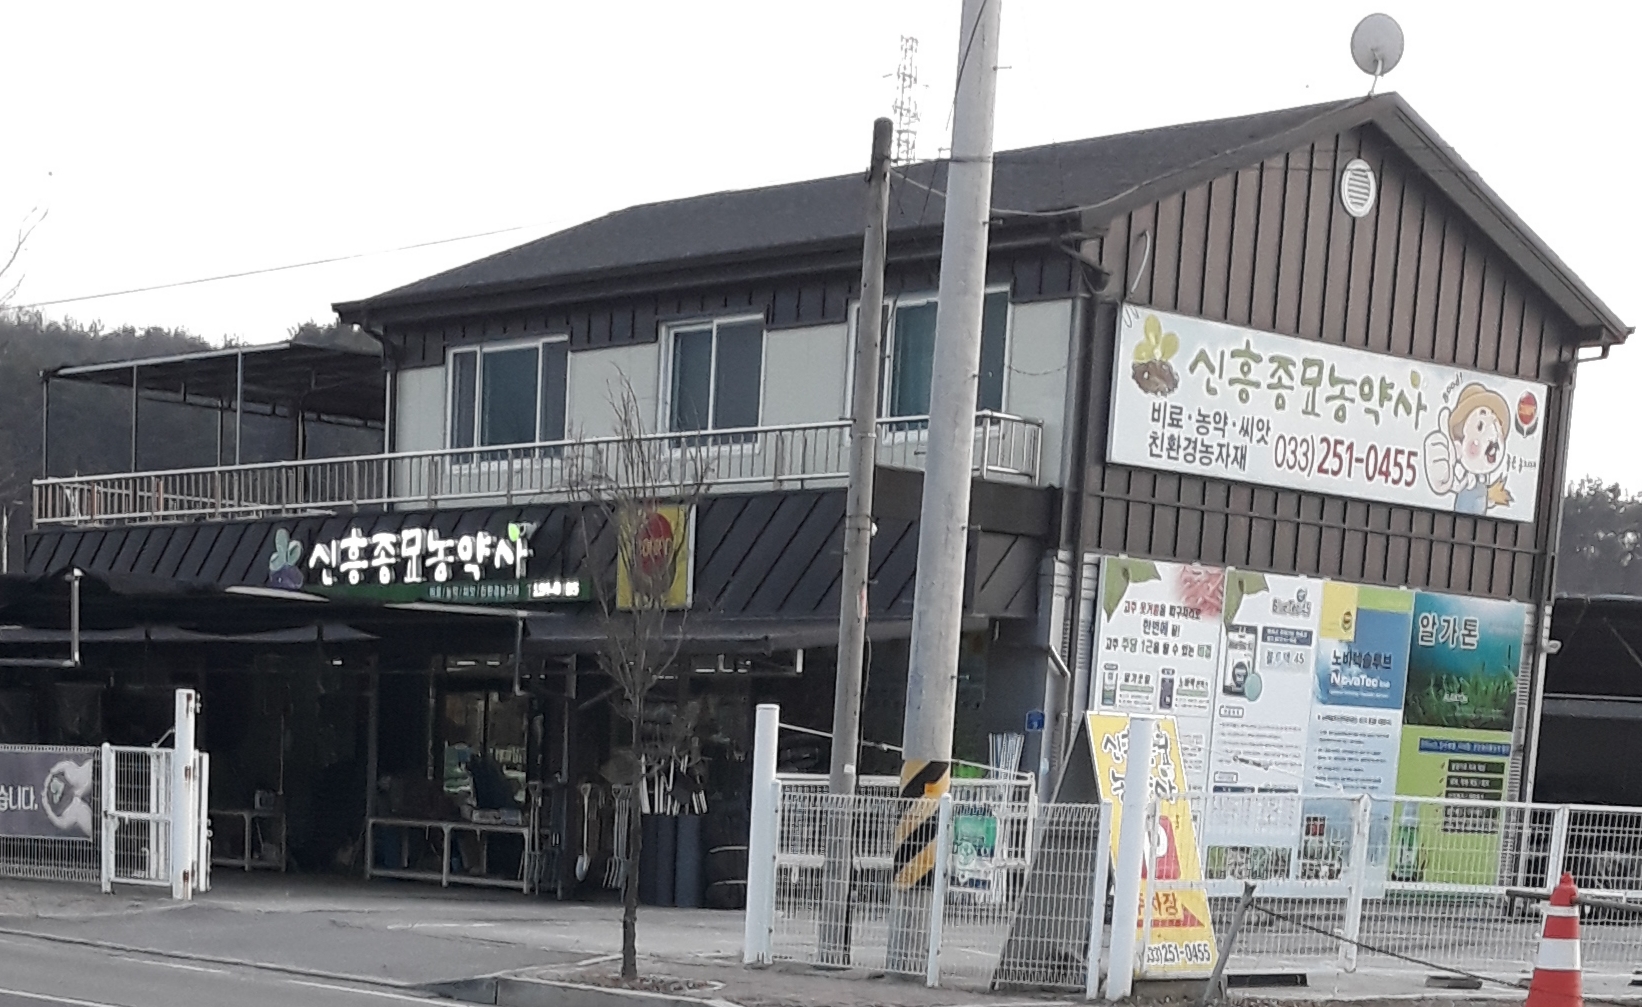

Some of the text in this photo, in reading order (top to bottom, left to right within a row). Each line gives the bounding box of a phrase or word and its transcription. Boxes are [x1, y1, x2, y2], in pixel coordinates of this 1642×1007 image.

[1188, 339, 1428, 430] 신흥종묘농약사
[1149, 431, 1247, 471] 친환경농자재
[308, 525, 532, 586] 신흥종묘농약사
[1293, 652, 1305, 664] 45
